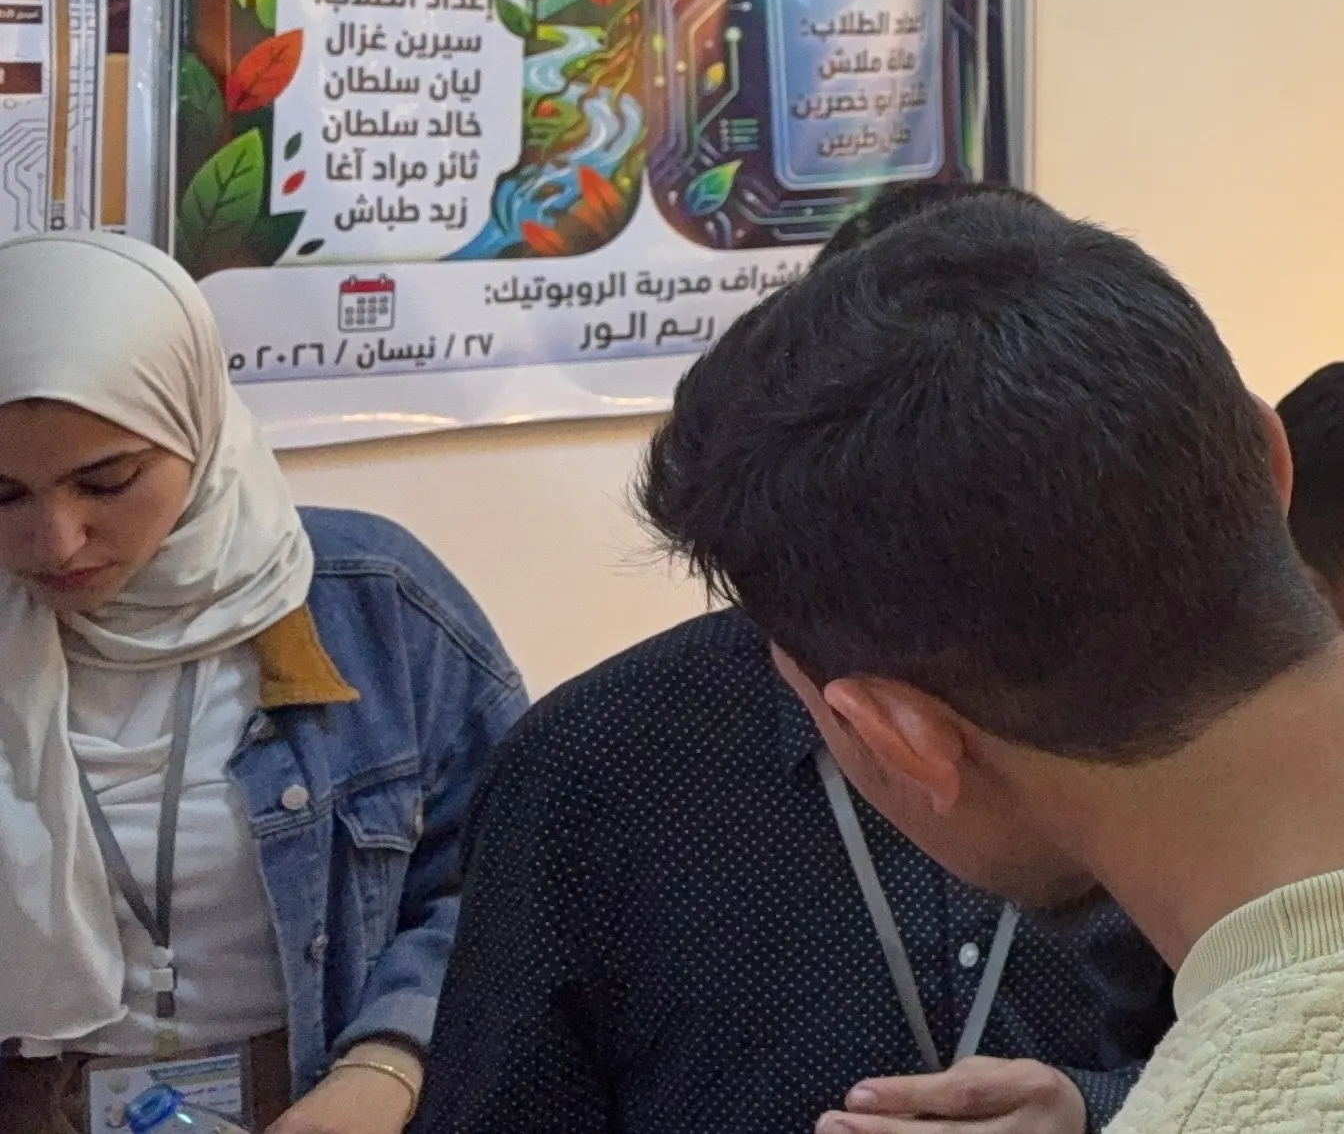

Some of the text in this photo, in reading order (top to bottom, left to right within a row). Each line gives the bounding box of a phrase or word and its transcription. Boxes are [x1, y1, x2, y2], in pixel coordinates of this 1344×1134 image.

[325, 22, 482, 59] سيرين غزال
[800, 10, 891, 42] الطلاب:
[324, 66, 482, 102] ليان سلطان
[322, 109, 483, 144] خالد سلطان
[325, 146, 481, 187] ثائر مراد آغا
[334, 193, 468, 232] زيد طباش
[484, 271, 627, 311] الروبوتيك:
[635, 270, 712, 303] مدربة
[444, 332, 456, 360] /
[464, 332, 494, 358] ٢٧
[580, 312, 716, 350] ريم الور
[256, 341, 326, 371] ٢٠٢٦
[334, 338, 348, 365] /
[356, 336, 437, 370] نيسان
